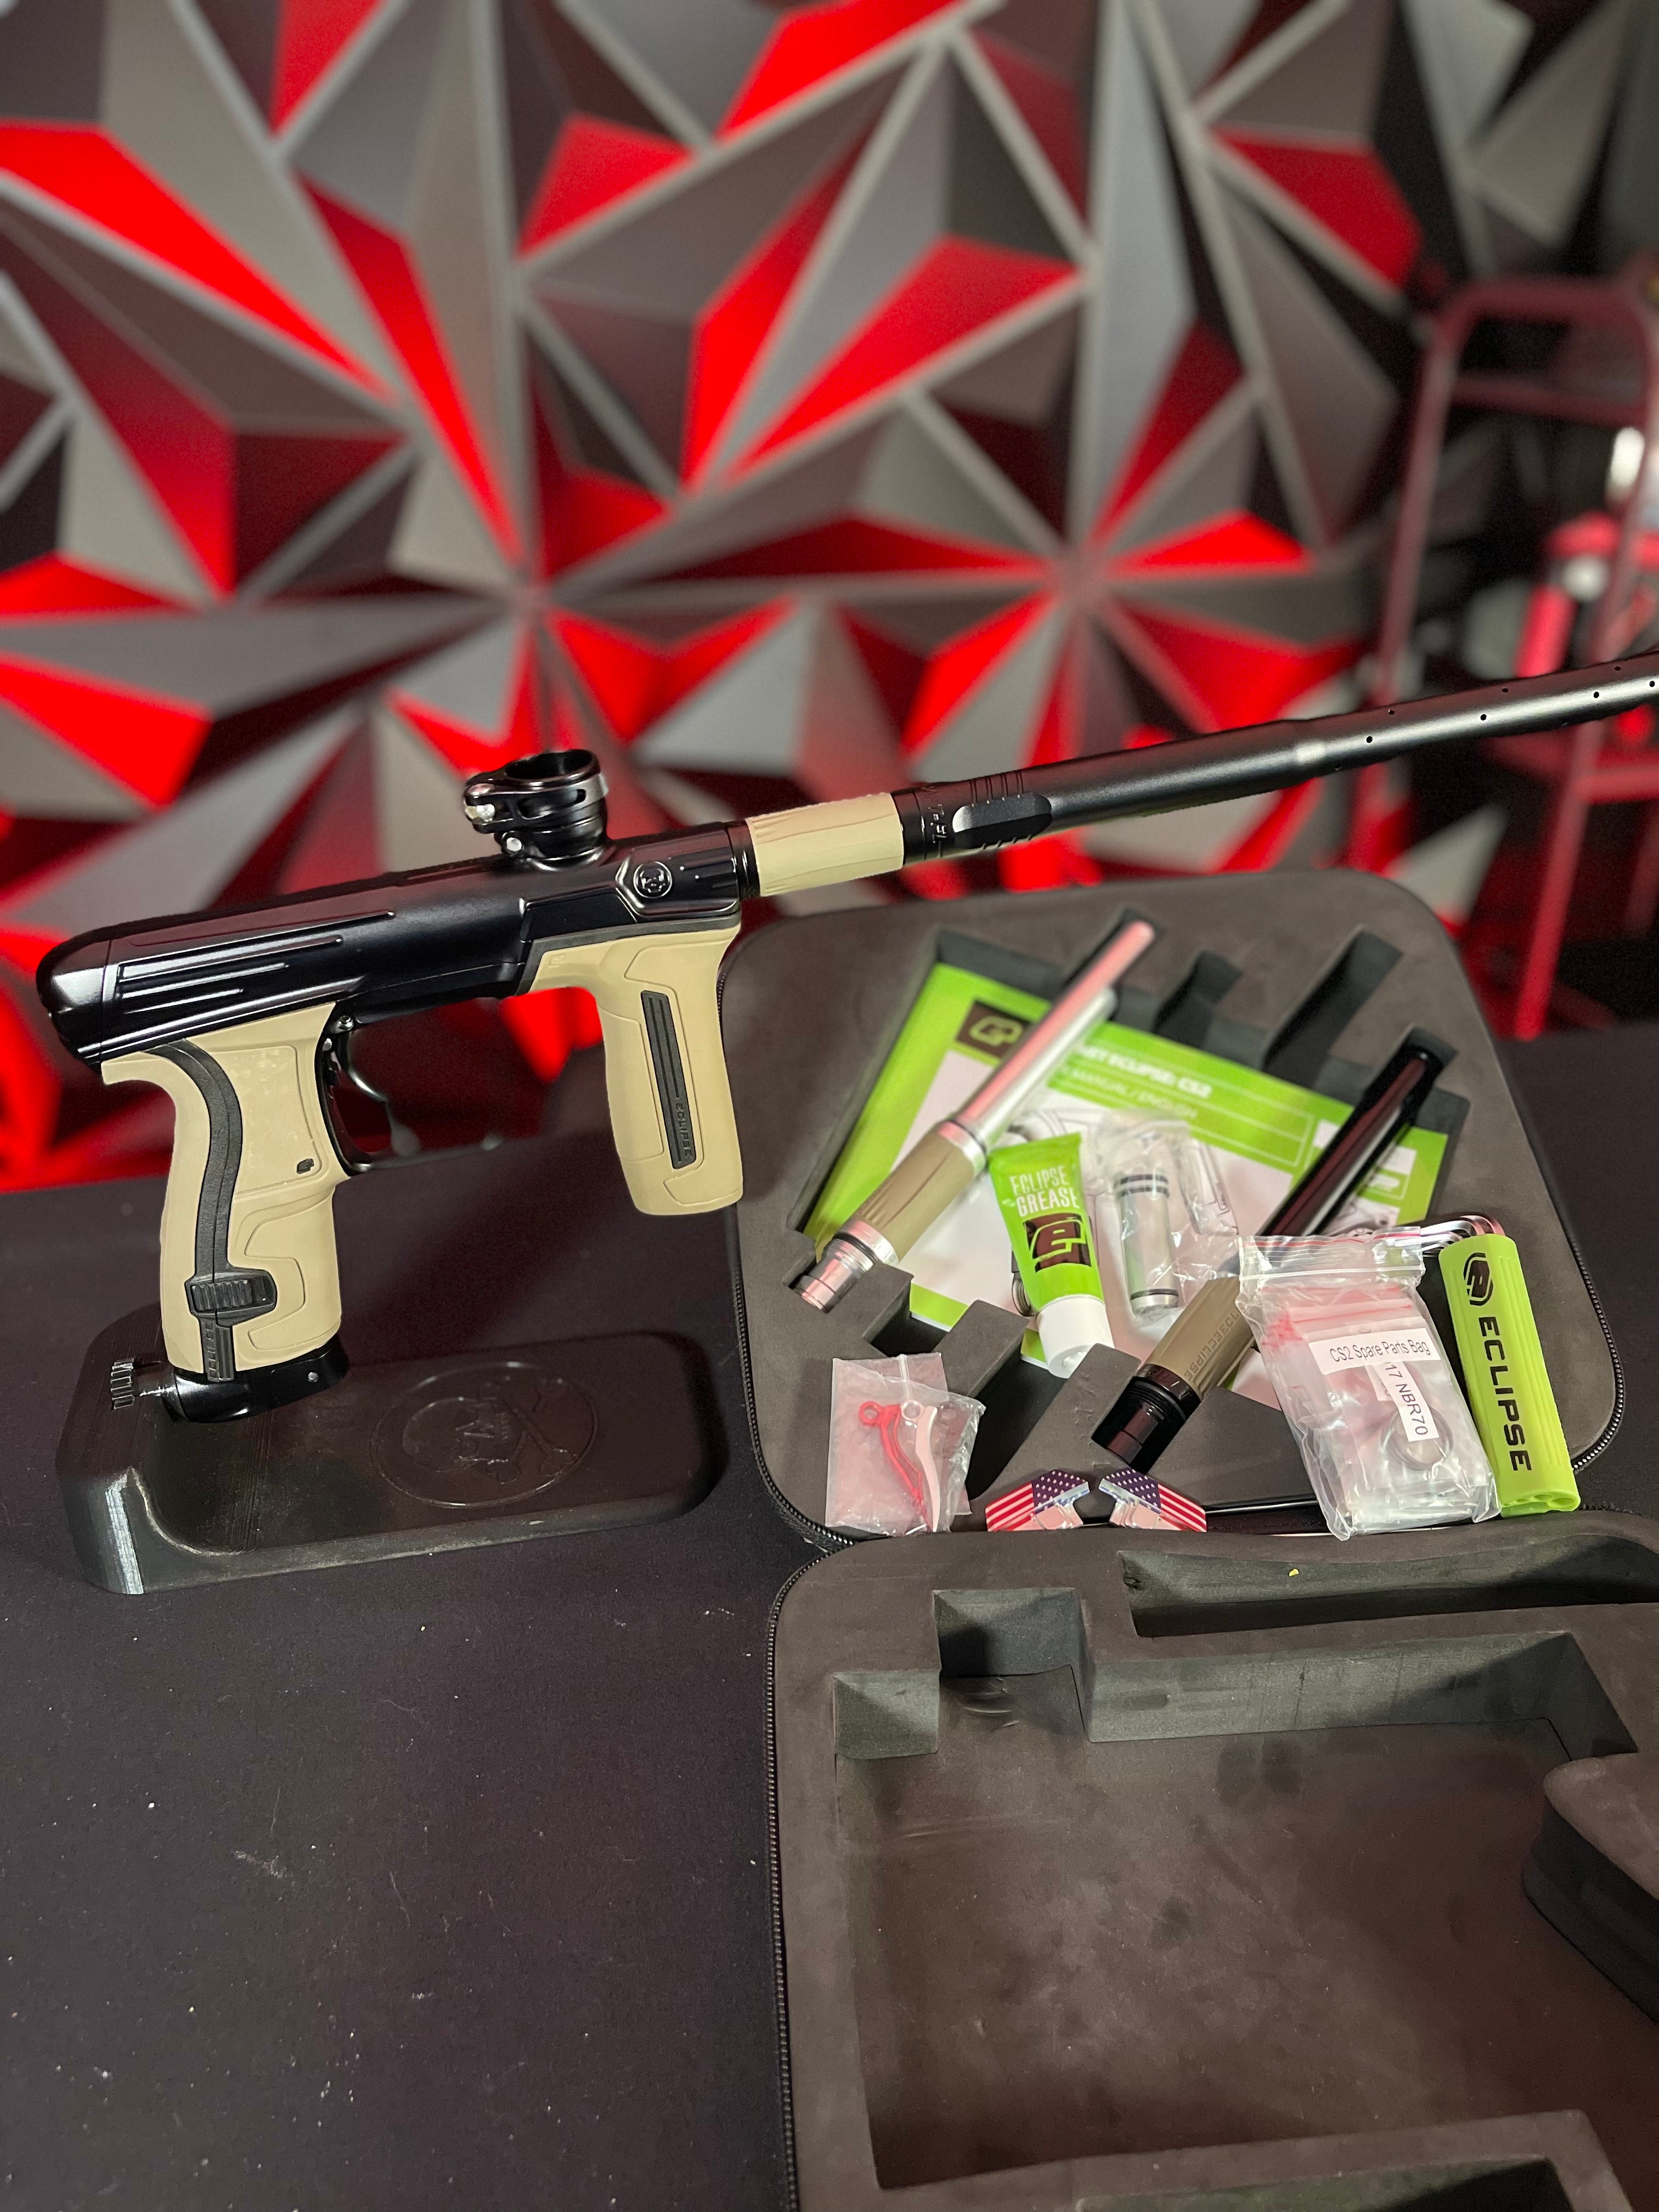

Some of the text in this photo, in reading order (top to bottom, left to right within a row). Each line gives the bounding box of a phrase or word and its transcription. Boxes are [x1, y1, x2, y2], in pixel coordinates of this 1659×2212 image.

[675, 1103, 692, 1158] ECLIPSE
[1009, 1165, 1069, 1196] ECLIPSE
[1016, 1187, 1080, 1217] GREASE
[1330, 1339, 1431, 1362] CS2 Spare Parts Bag
[1395, 1383, 1428, 1435] NBR70
[1479, 1316, 1532, 1471] ECLIPSE
